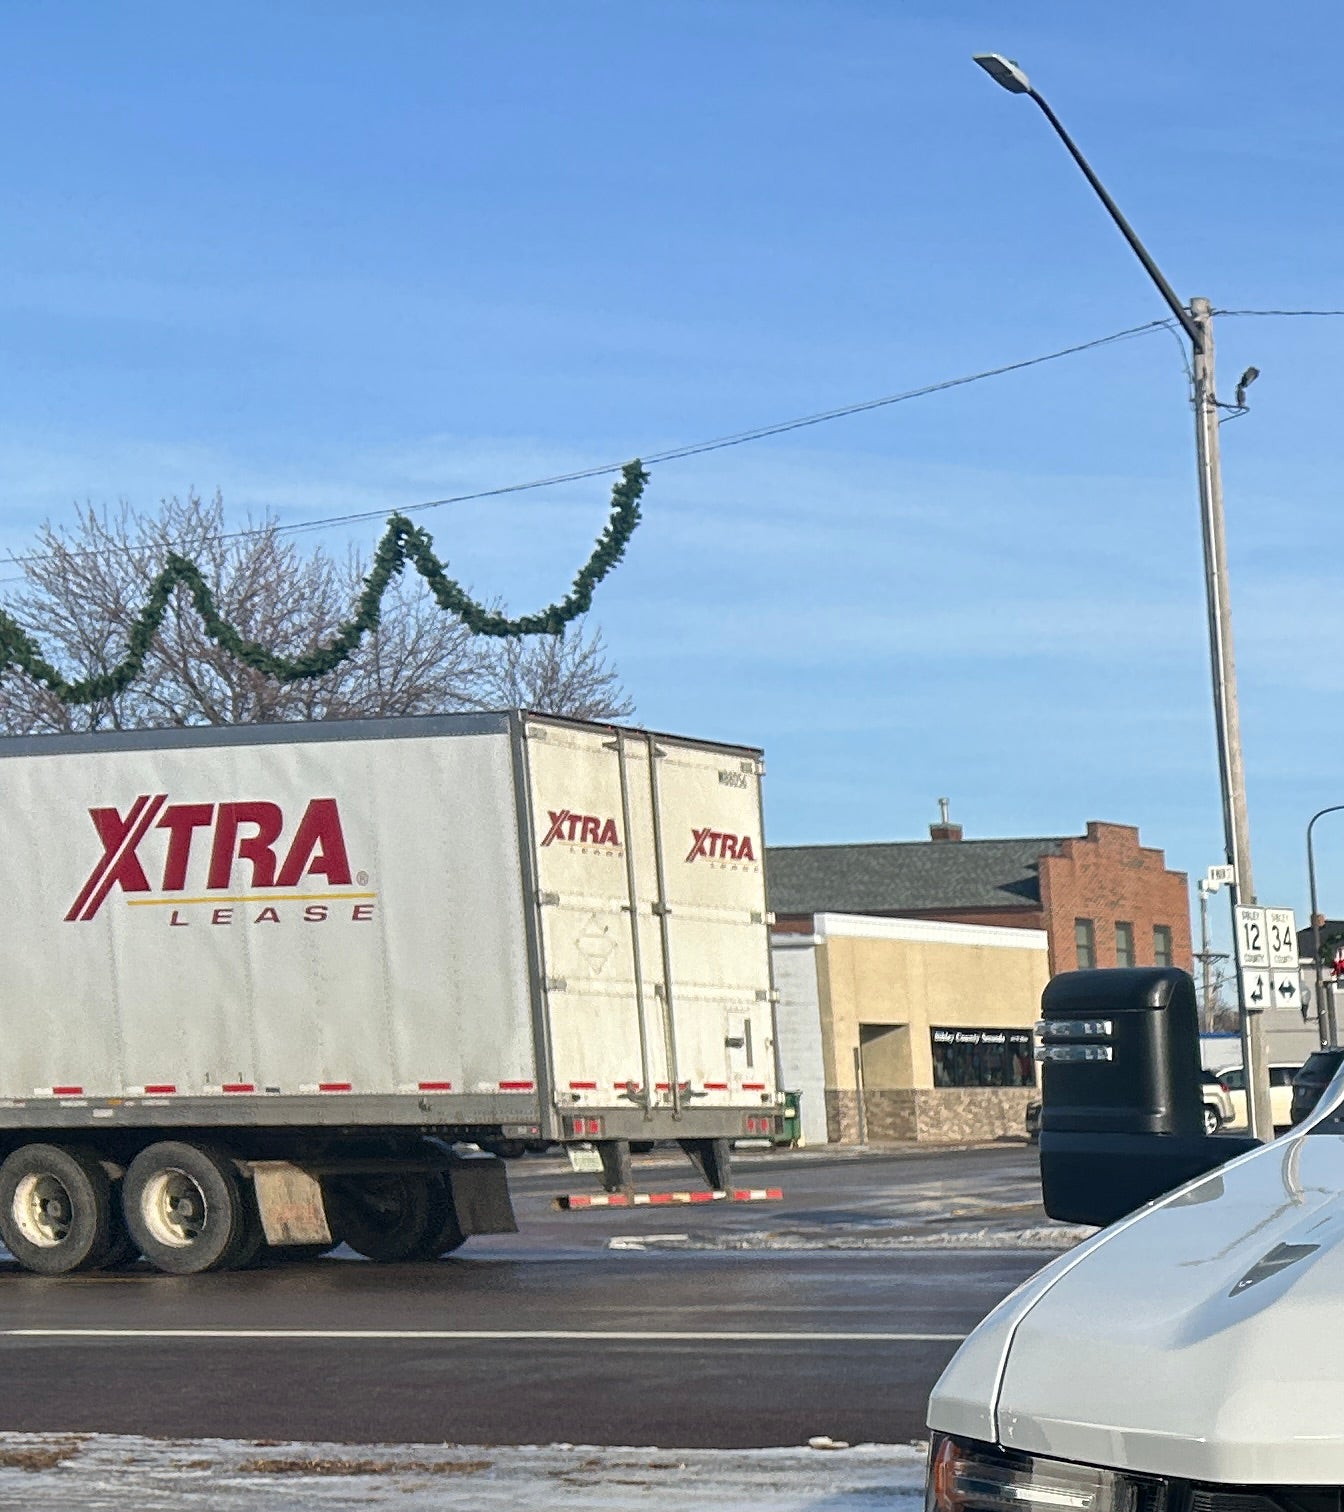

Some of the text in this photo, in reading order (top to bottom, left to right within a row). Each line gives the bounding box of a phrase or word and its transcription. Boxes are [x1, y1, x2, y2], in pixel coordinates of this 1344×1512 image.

[540, 809, 620, 847] XTRA
[63, 794, 353, 921] XTRA
[684, 828, 755, 864] XTRA
[168, 904, 375, 927] LEASE
[1244, 922, 1261, 951] 12
[1271, 924, 1292, 952] 34
